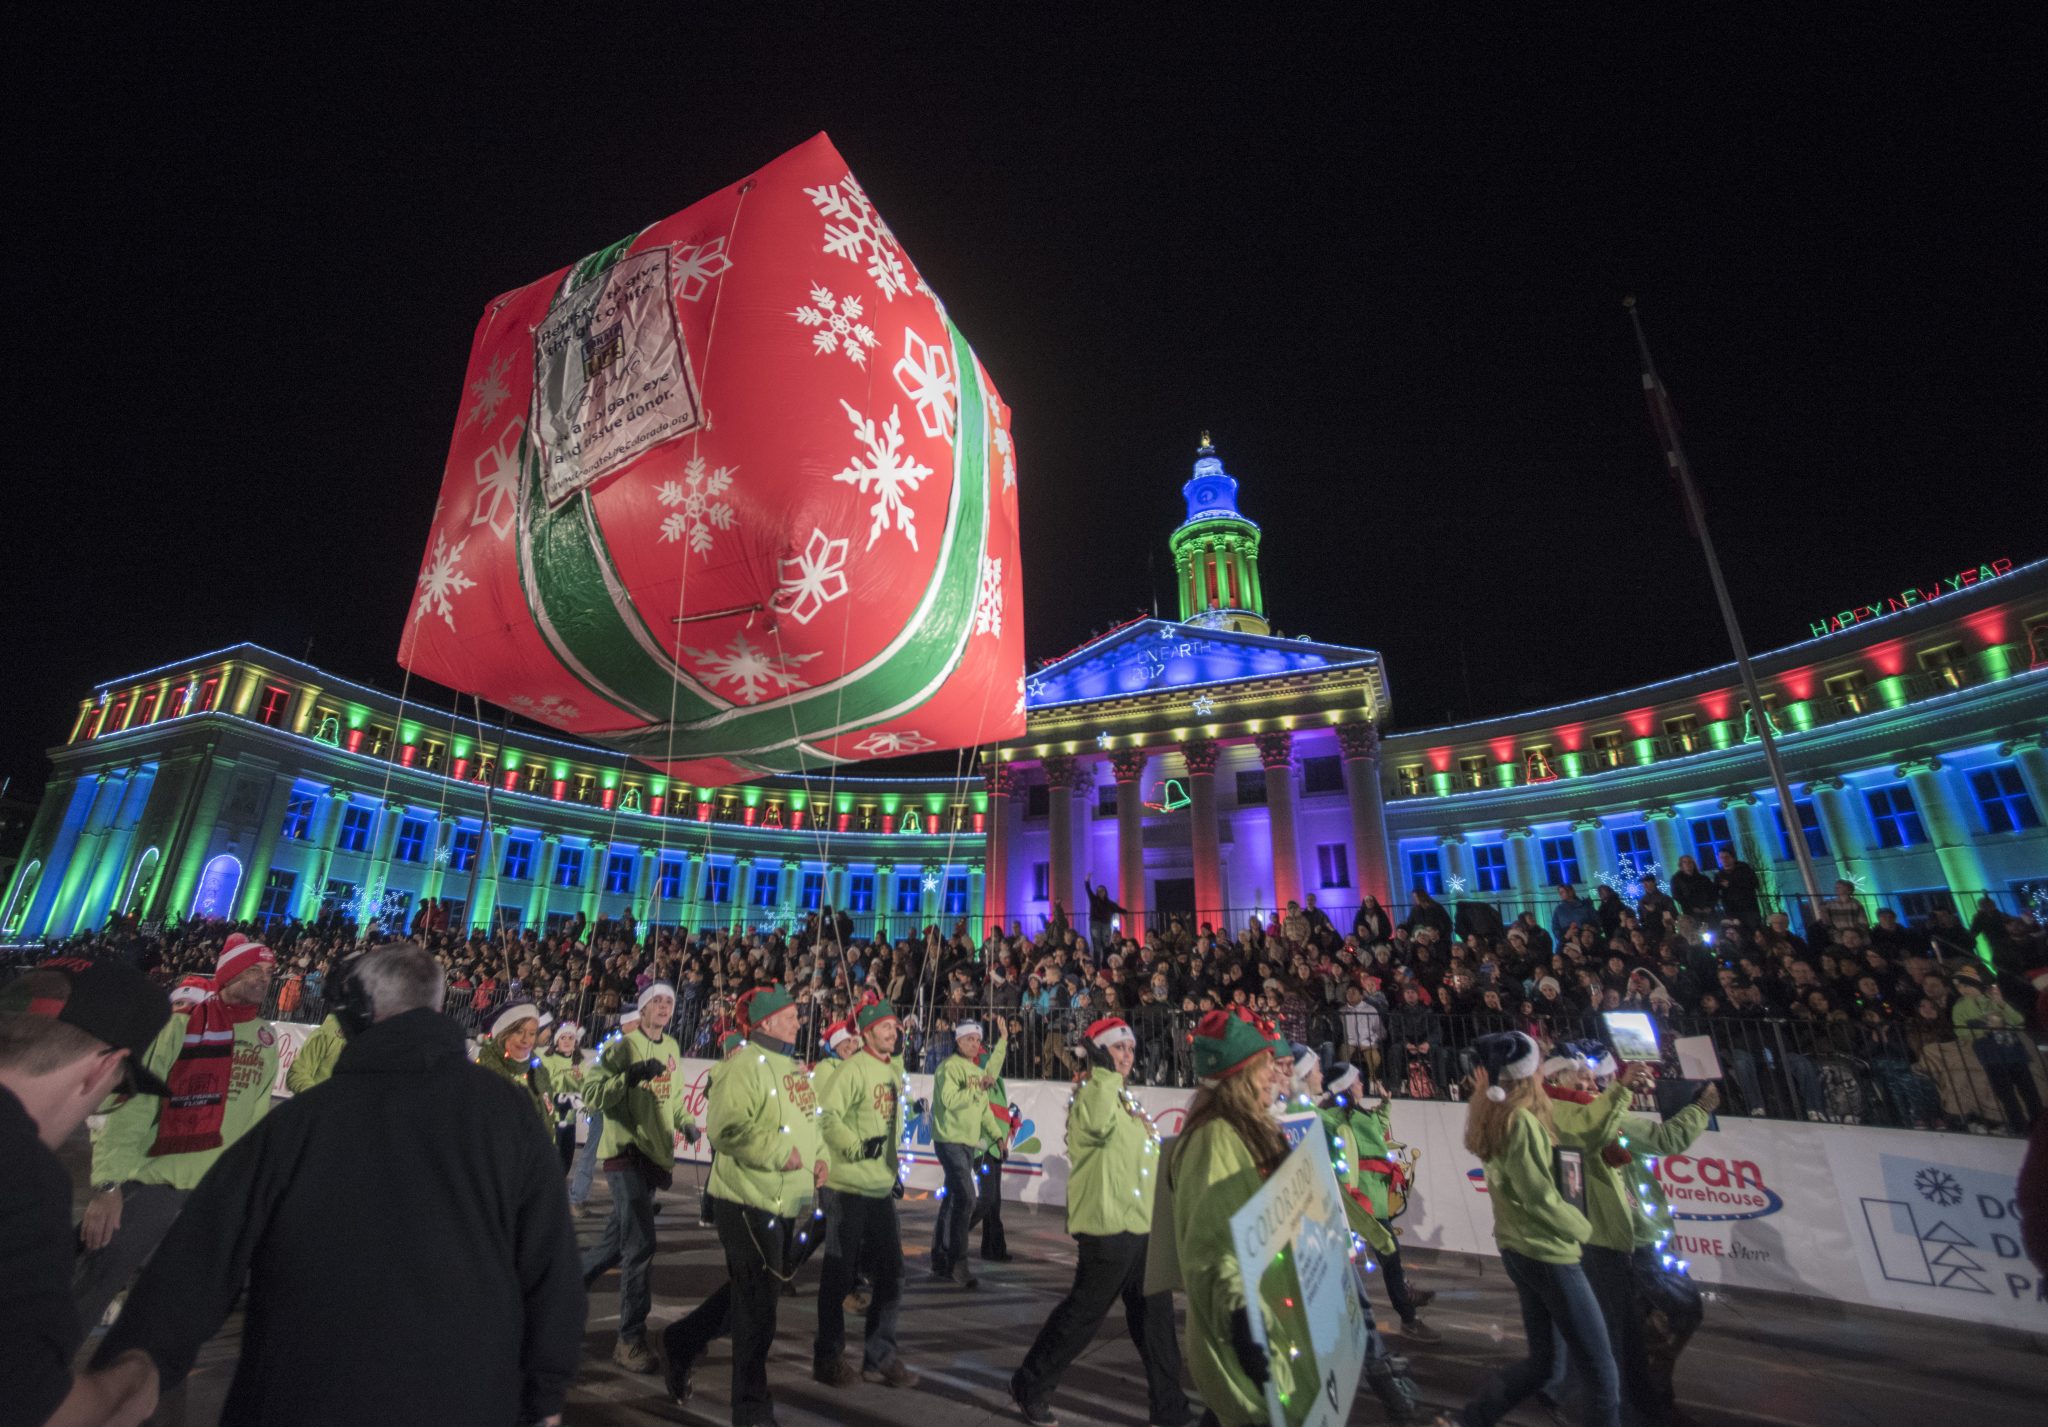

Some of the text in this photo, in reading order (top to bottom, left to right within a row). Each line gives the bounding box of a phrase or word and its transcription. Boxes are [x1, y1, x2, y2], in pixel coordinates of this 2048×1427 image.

[554, 389, 675, 464] and tissue donor.
[572, 419, 592, 434] an
[642, 372, 670, 392] eye
[1810, 558, 2012, 638] HAPPY NEW YEAR
[1132, 664, 1165, 680] 2017
[1160, 641, 1211, 660] EARTH
